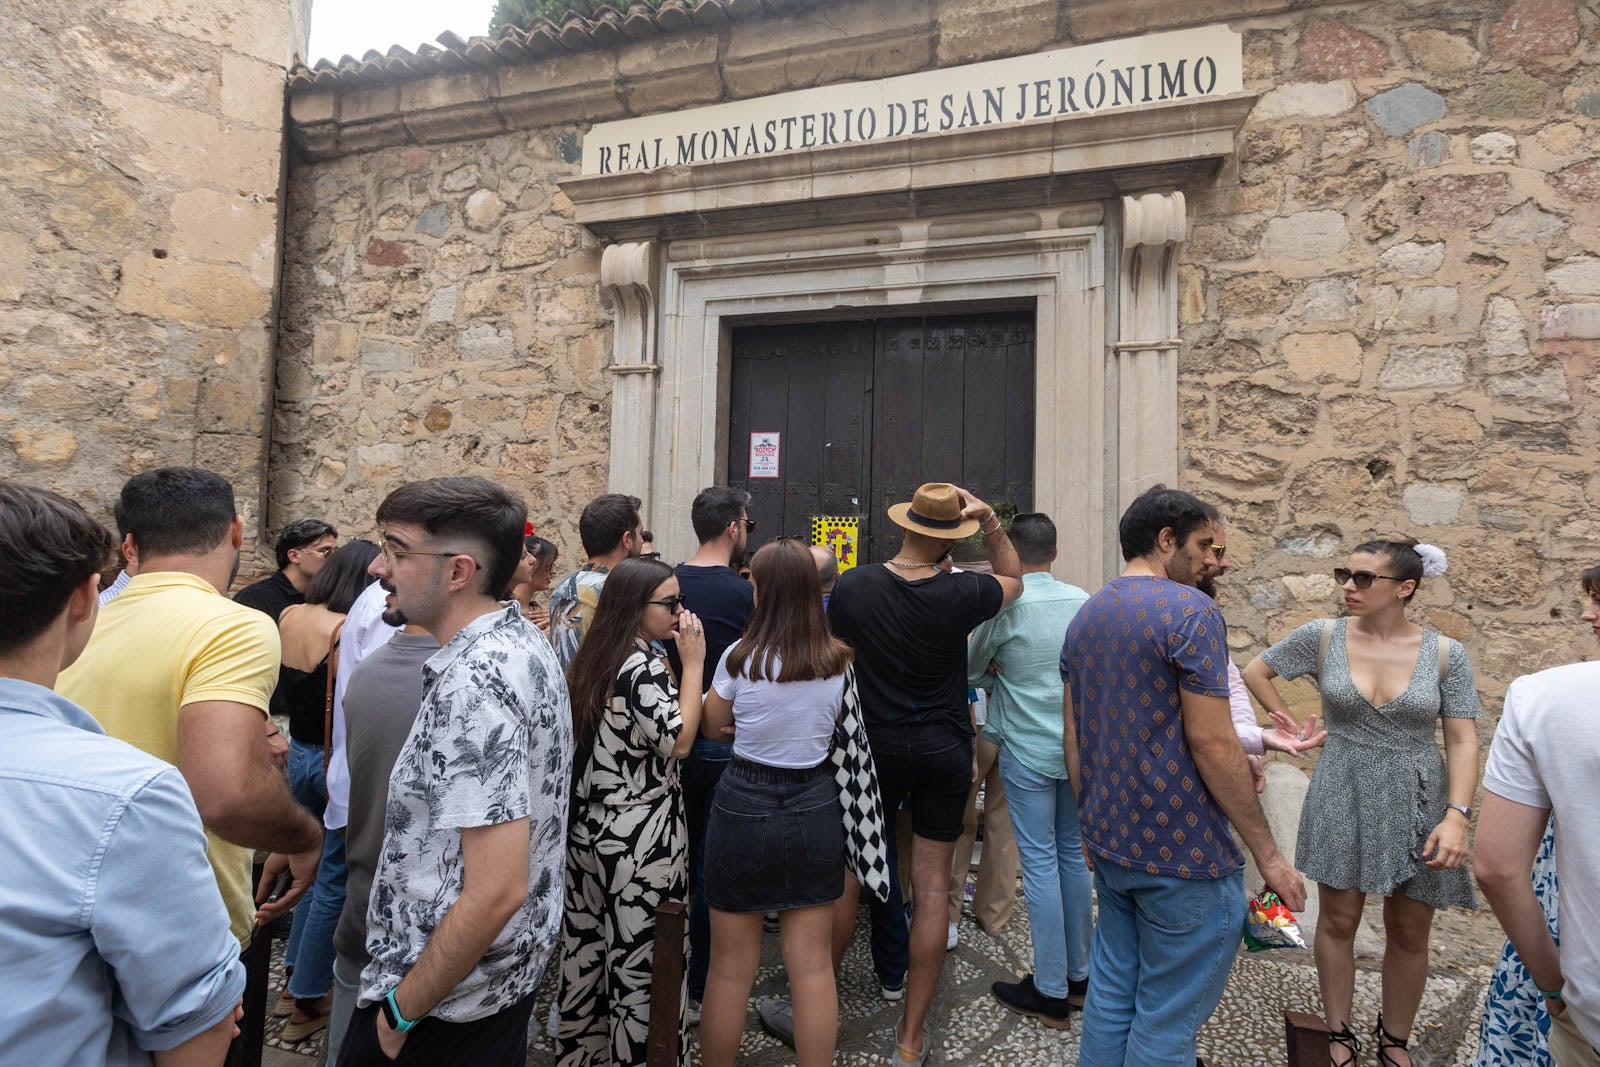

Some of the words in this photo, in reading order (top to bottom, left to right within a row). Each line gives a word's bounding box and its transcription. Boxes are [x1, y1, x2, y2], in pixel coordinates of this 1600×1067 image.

[598, 138, 667, 175] REAL
[676, 107, 876, 165] MONASTERIO
[887, 98, 929, 137] DE
[939, 87, 1006, 131] SAN
[1016, 56, 1217, 120] JERÓNIMO
